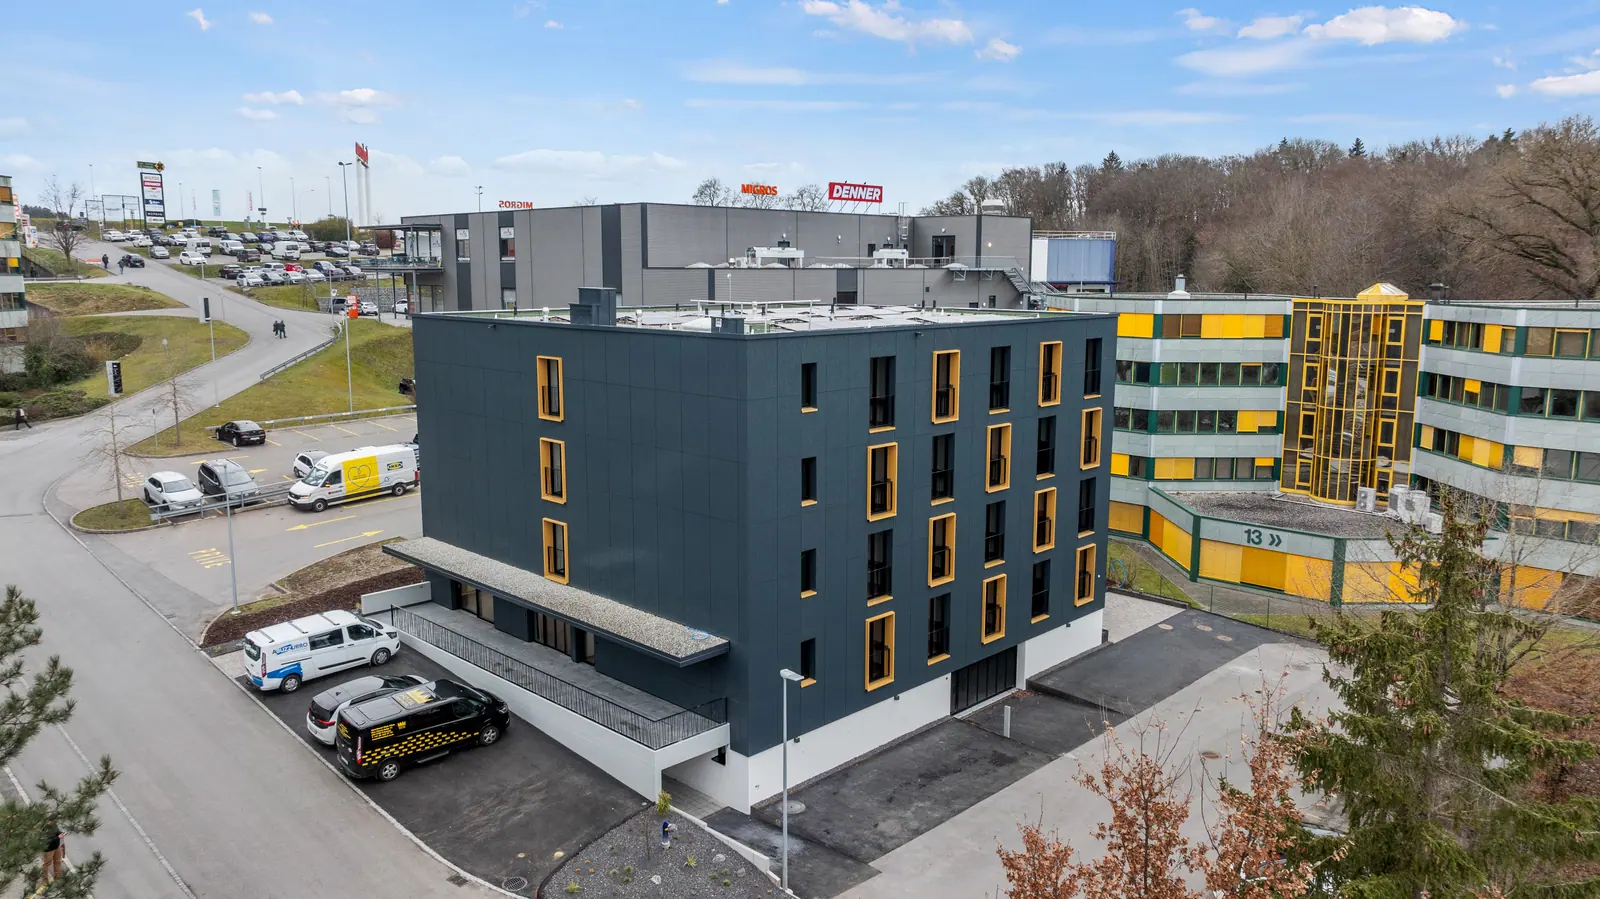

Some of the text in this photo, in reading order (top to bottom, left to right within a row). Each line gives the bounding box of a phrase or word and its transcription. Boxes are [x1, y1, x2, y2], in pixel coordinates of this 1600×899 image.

[741, 183, 778, 195] MIGROS
[833, 184, 880, 200] DENNER
[1244, 529, 1262, 545] 13
